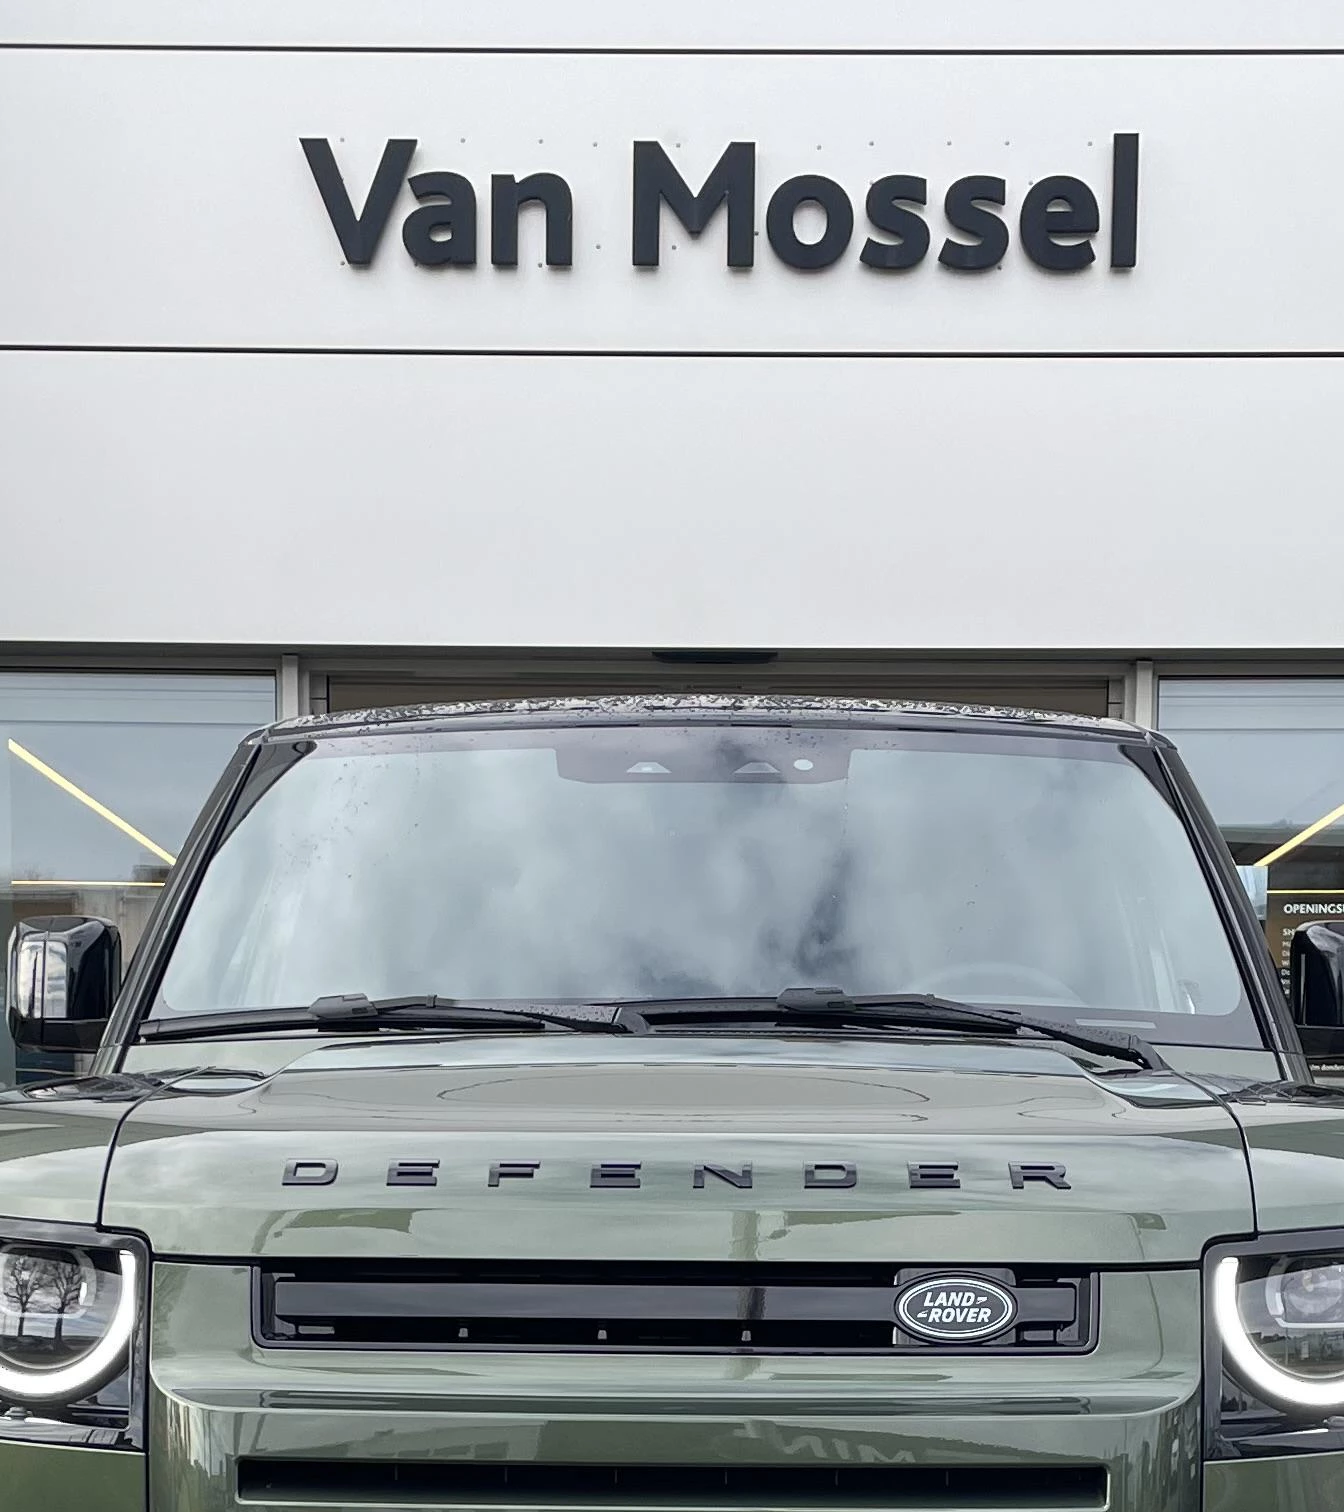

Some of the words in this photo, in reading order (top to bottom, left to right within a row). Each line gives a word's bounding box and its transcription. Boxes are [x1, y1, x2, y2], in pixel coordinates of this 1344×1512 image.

[299, 136, 574, 267] Van
[632, 131, 1140, 271] Mossel
[282, 1156, 1072, 1190] DEFENDER
[923, 1291, 976, 1307] LAND
[927, 1307, 992, 1323] ROVER
